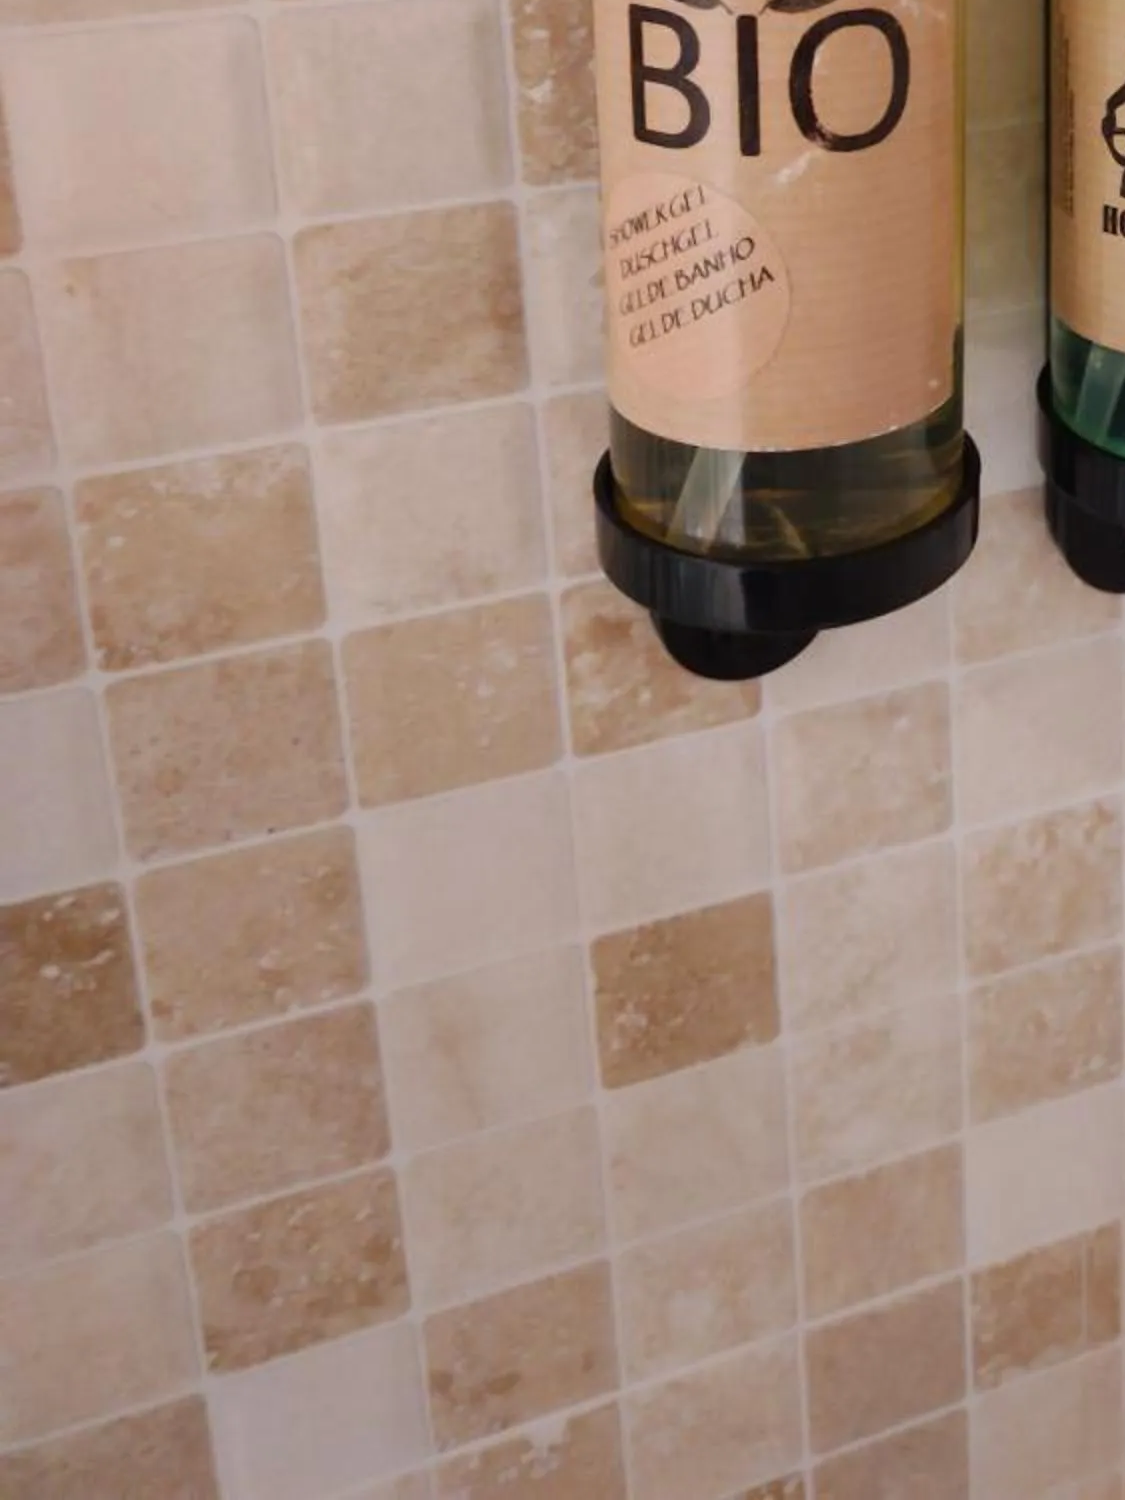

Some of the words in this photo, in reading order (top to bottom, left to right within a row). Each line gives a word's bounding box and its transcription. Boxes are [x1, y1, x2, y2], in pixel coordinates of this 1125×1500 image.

[629, 3, 910, 157] BIO
[674, 236, 756, 291] BANHO
[690, 265, 776, 321] DUCHA
